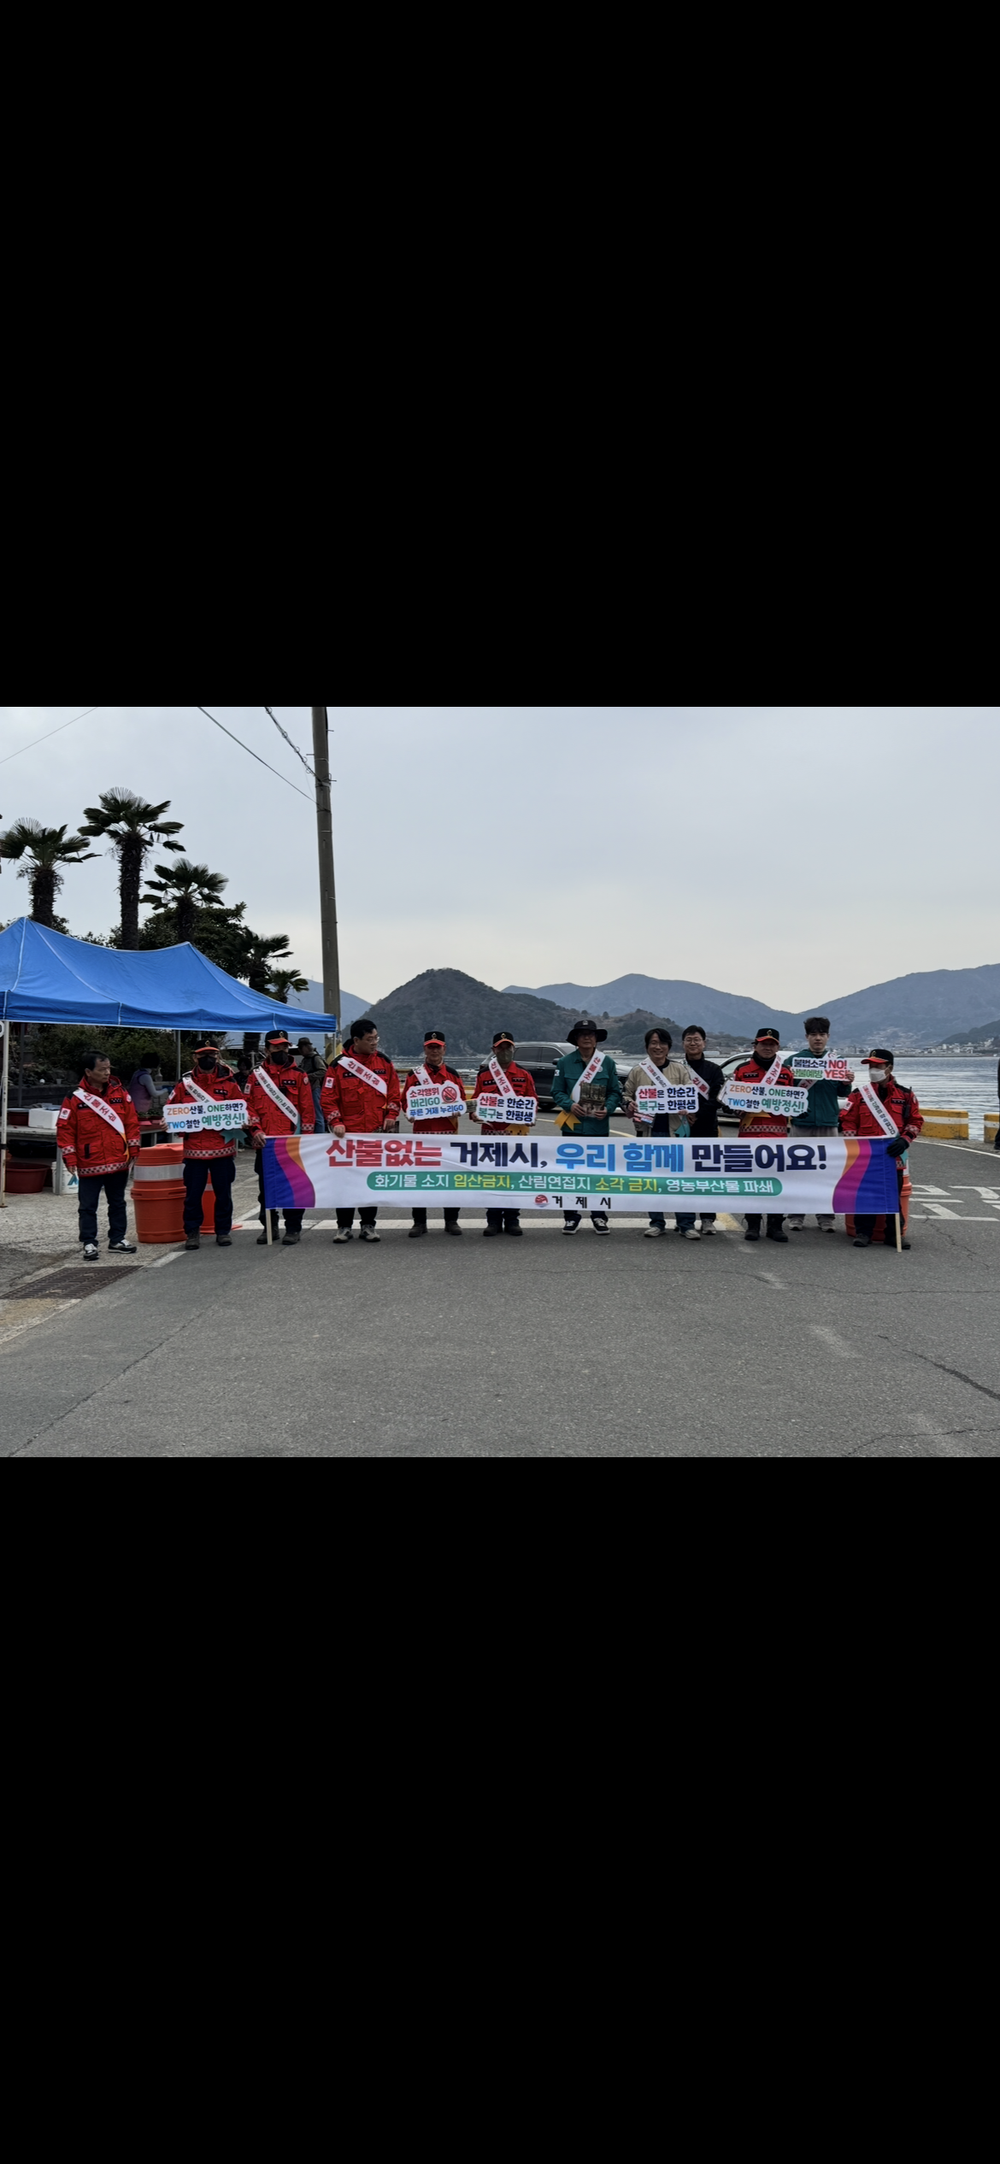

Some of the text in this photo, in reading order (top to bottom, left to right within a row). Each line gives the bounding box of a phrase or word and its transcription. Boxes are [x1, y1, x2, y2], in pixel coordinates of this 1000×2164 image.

[794, 1059, 847, 1069] 불법소각 NO!
[792, 1069, 823, 1078] 산불예방
[409, 1087, 440, 1098] 소각행위
[639, 1087, 695, 1099] 산불은 한순간
[768, 1088, 805, 1099] ONE하면?
[207, 1102, 243, 1113] ONE하면?
[410, 1097, 440, 1108] 버리GO
[480, 1096, 534, 1110] 산불은 한순간
[639, 1100, 696, 1111] 복구는 한평생
[727, 1098, 805, 1113] TWO철한 예방정신!
[410, 1104, 464, 1117] 푸른 거제 누리GO
[479, 1107, 533, 1122] 복구는 한평생
[167, 1113, 245, 1129] TWO철한 예방정신!
[326, 1140, 827, 1173] 산불없는 거제시, 우리 함께 만들어요!
[374, 1174, 774, 1193] 화기물 소지 입산금지, 산림연접지 소각 금지, 영농부산물 파쇄
